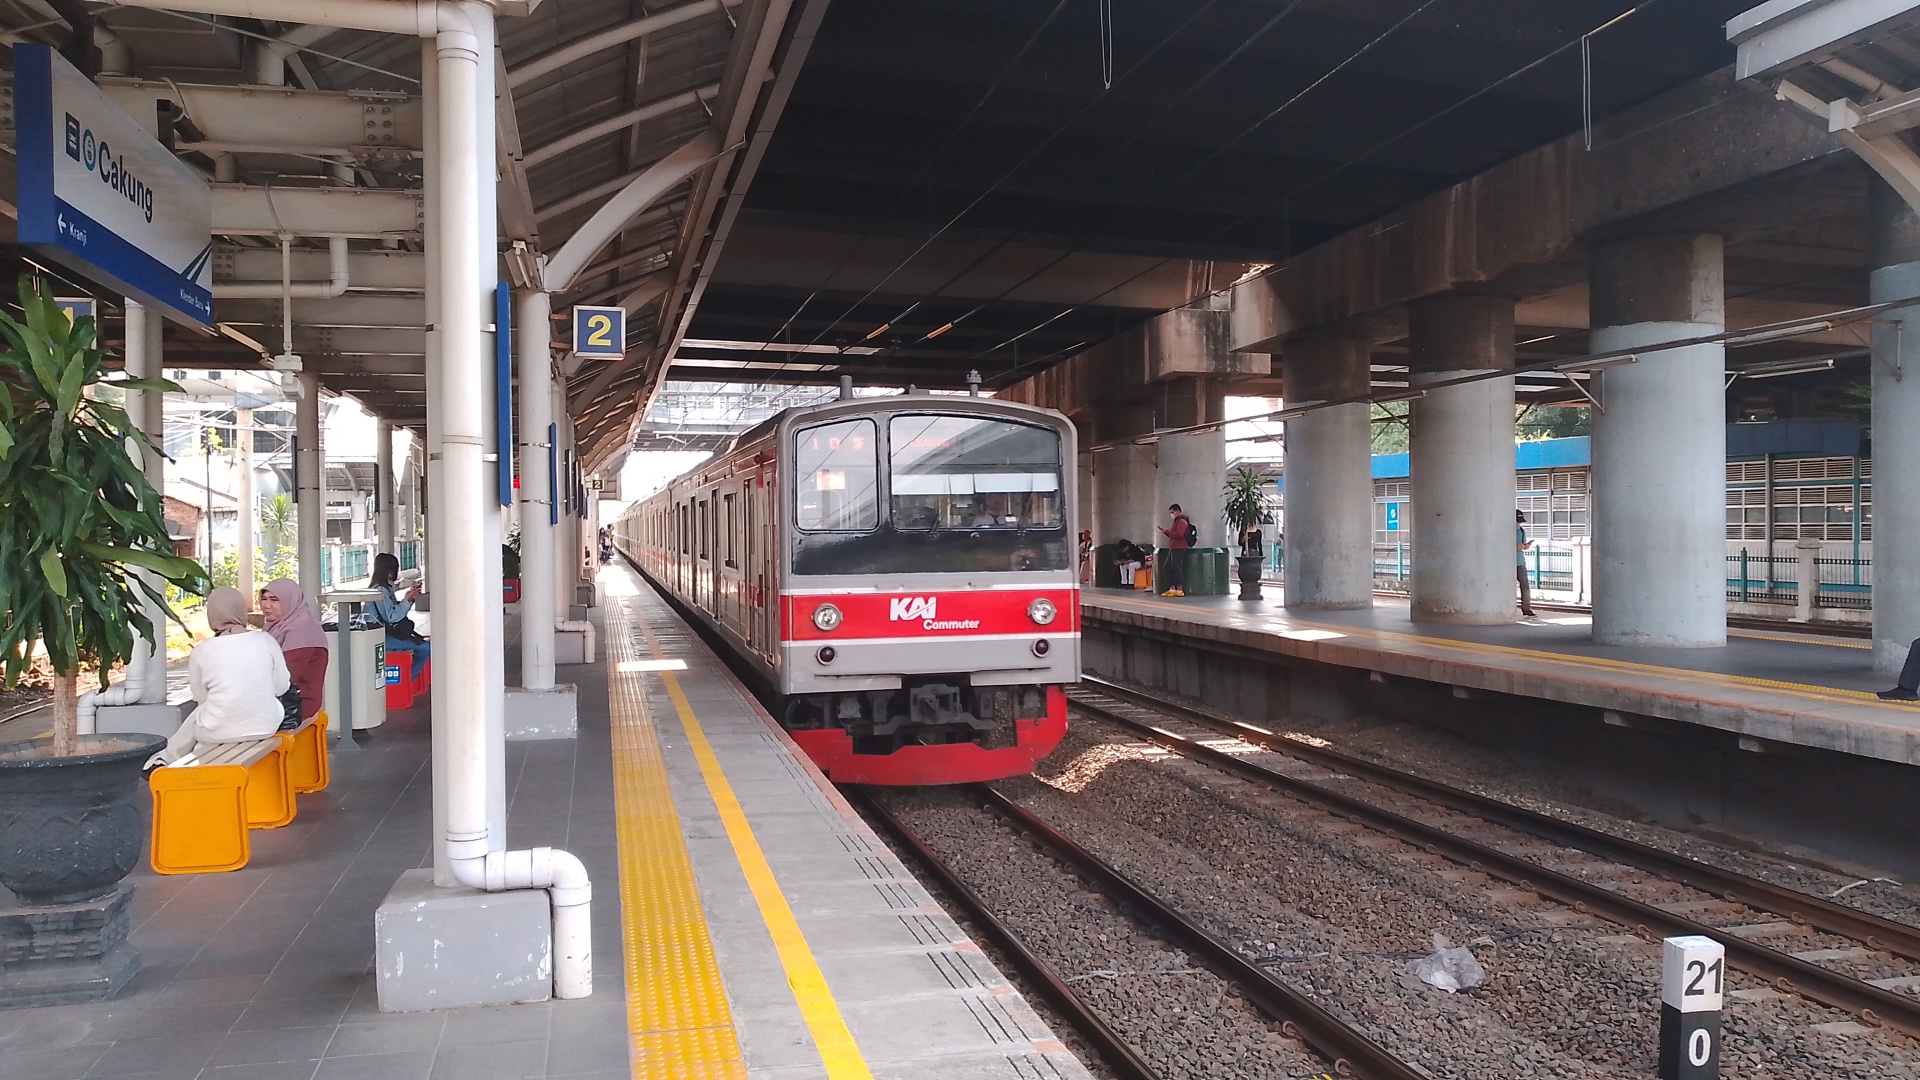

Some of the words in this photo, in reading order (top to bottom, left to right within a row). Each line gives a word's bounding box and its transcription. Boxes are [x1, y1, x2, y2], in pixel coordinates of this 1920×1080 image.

[98, 141, 153, 223] Cakung
[69, 221, 88, 246] Kranji
[587, 314, 612, 346] 2
[594, 480, 601, 488] 2
[889, 596, 937, 621] KAI
[922, 619, 980, 630] Commuter
[1684, 957, 1722, 997] 21
[1688, 1028, 1711, 1067] 0
